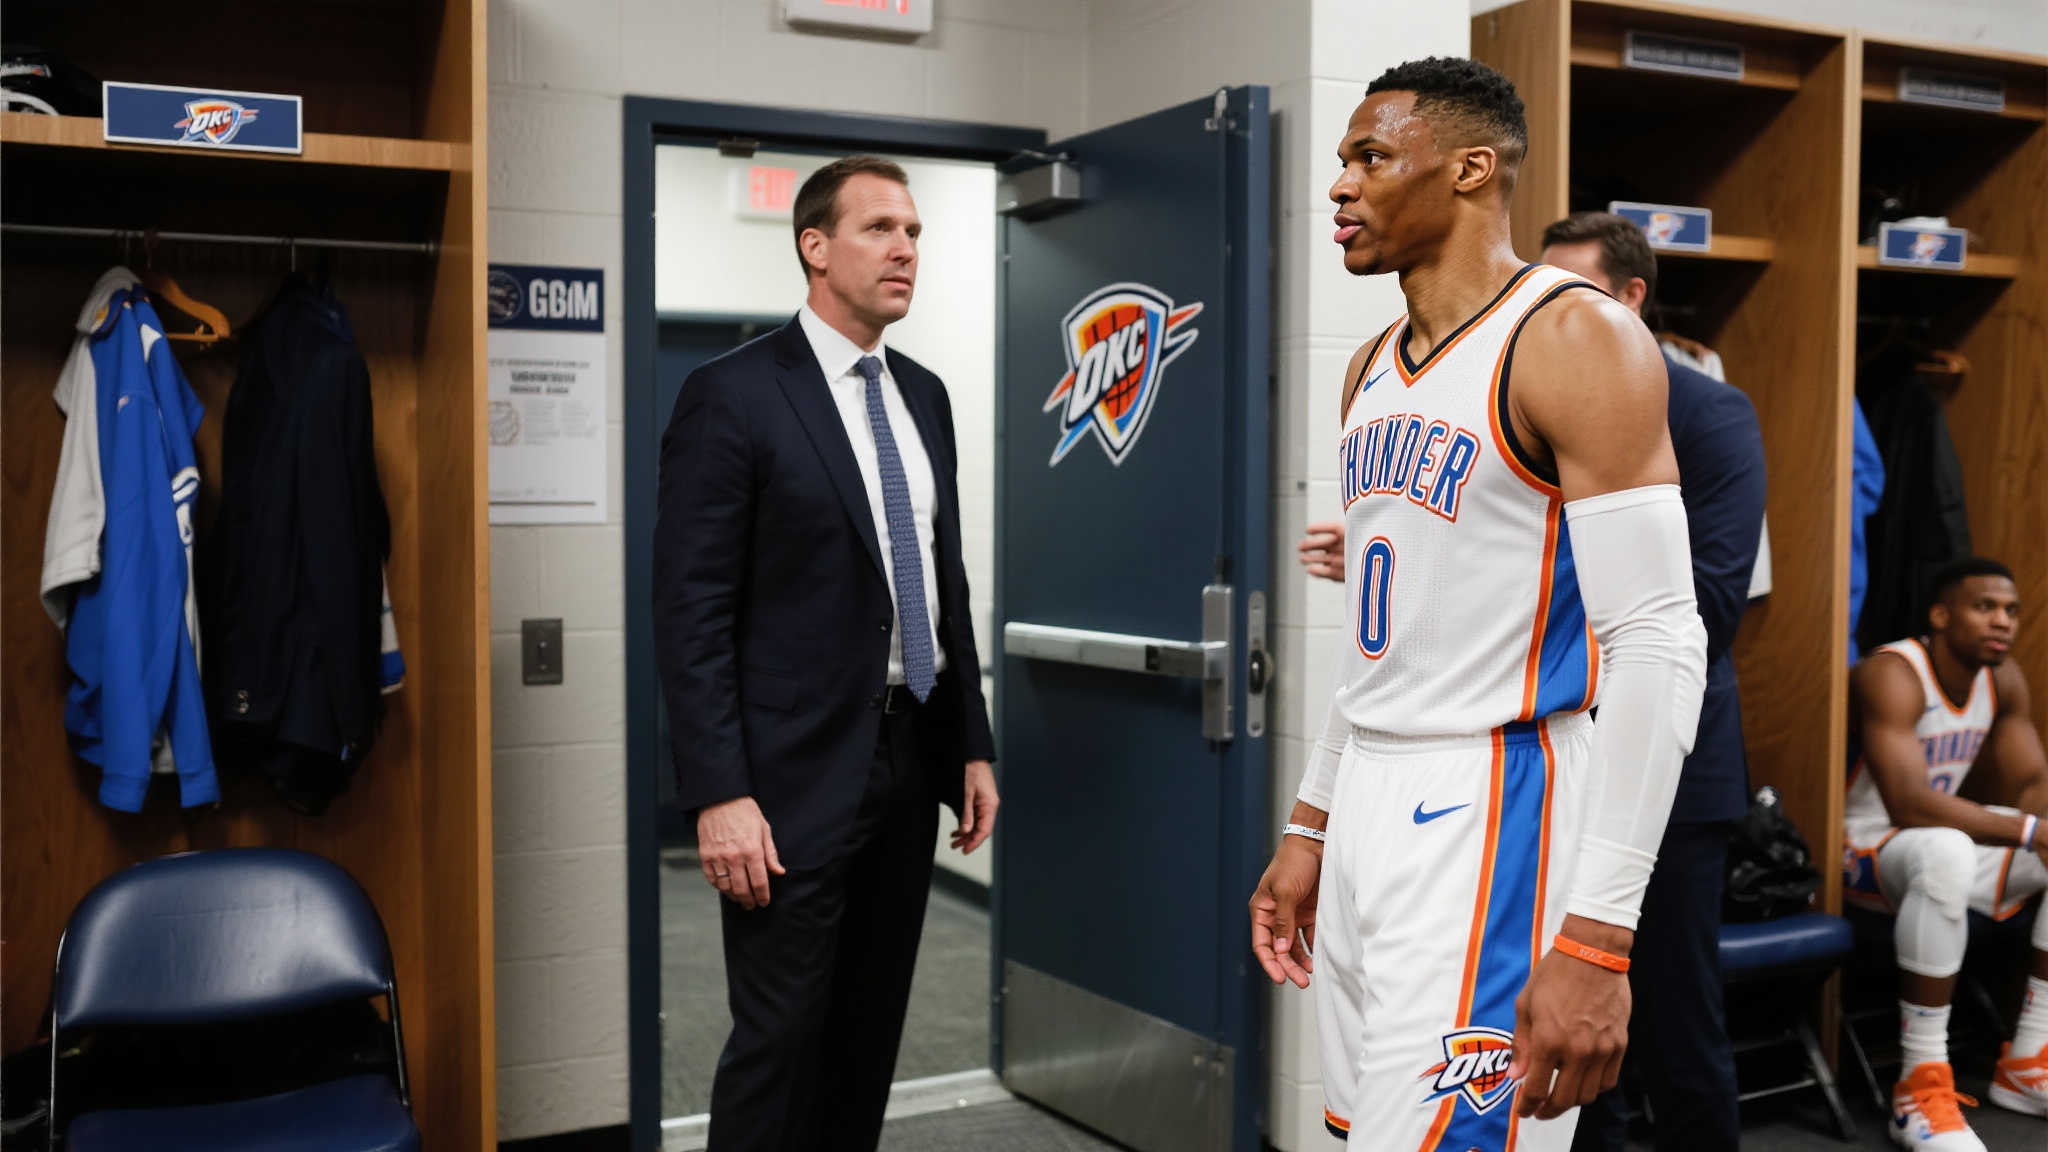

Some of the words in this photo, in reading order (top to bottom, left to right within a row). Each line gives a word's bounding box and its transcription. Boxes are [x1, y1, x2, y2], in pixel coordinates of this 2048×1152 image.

[1067, 318, 1146, 424] OKC
[1357, 535, 1396, 660] 0
[1434, 1048, 1513, 1092] OKC
